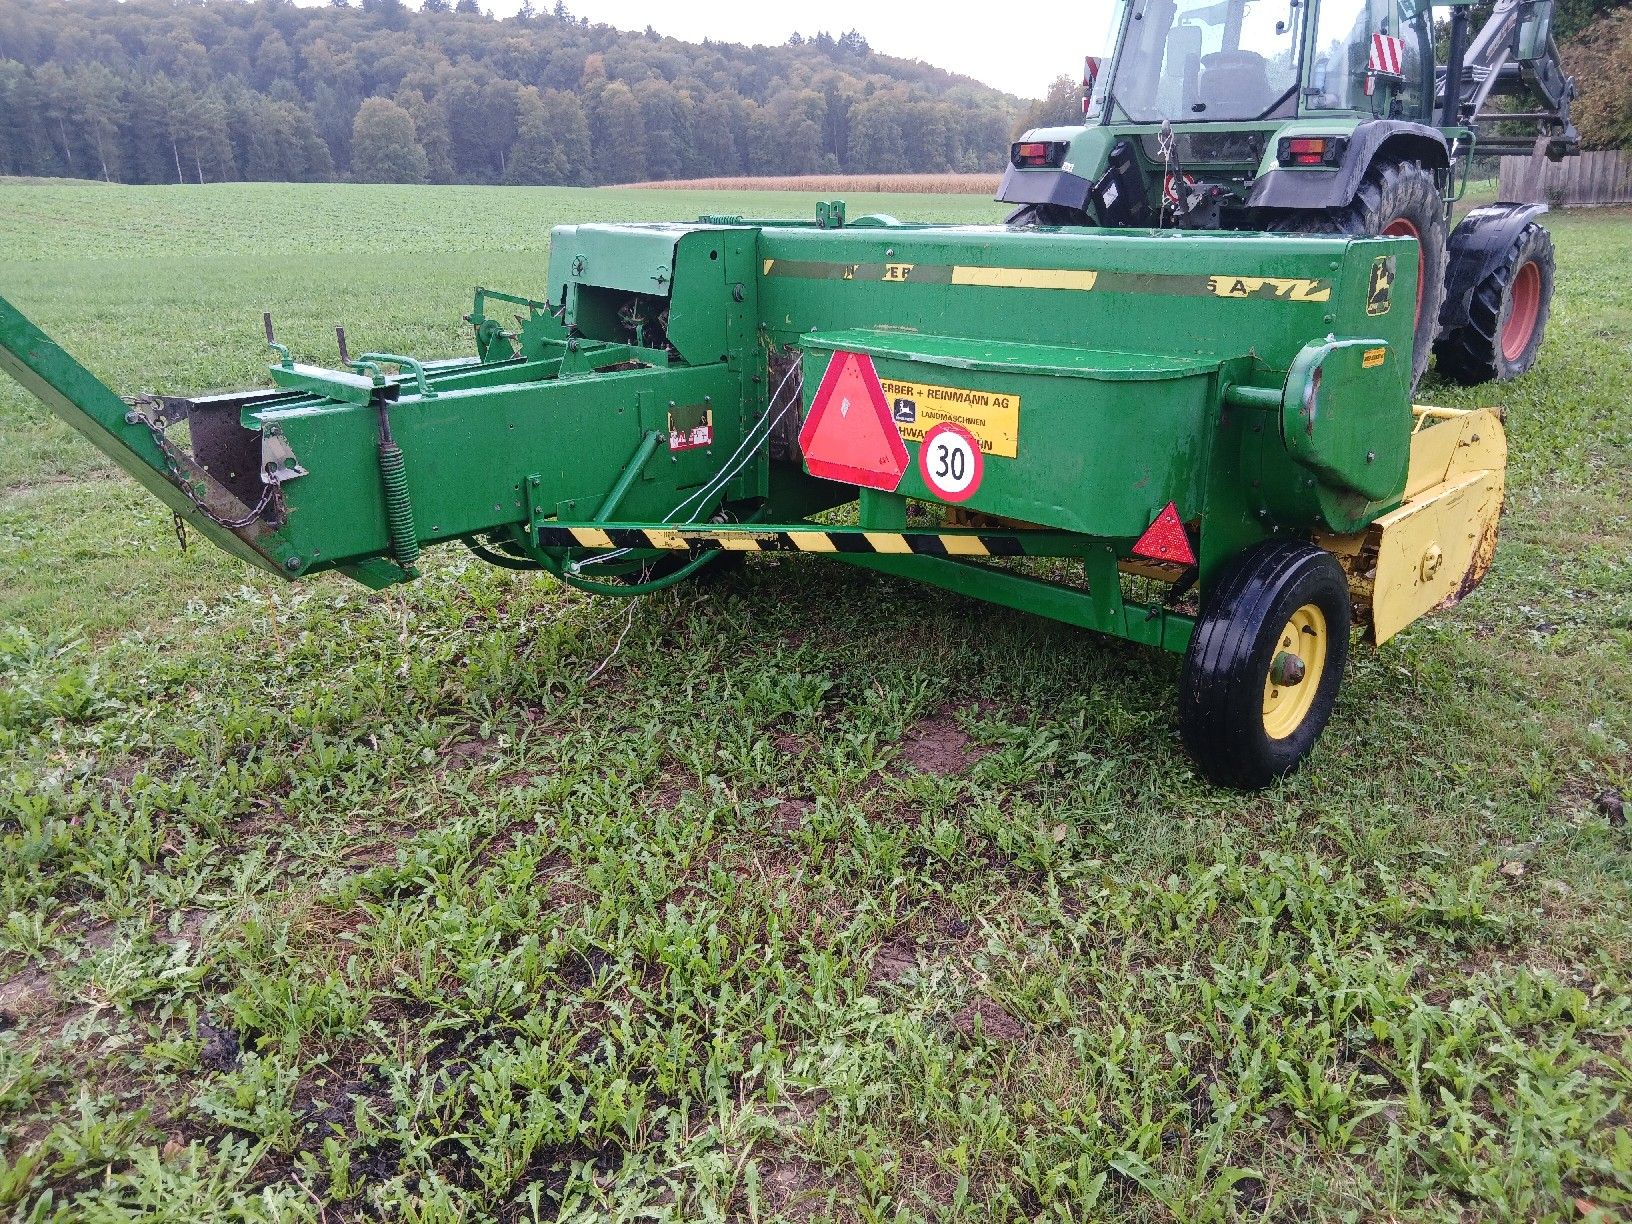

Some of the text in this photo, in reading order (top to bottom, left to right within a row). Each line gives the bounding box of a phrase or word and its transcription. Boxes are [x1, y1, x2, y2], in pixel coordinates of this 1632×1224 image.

[881, 382, 914, 396] ERBER
[927, 388, 989, 407] REINMANN
[992, 397, 1010, 409] AG
[921, 410, 986, 427] LANDMASCHINEN
[936, 444, 965, 480] 30
